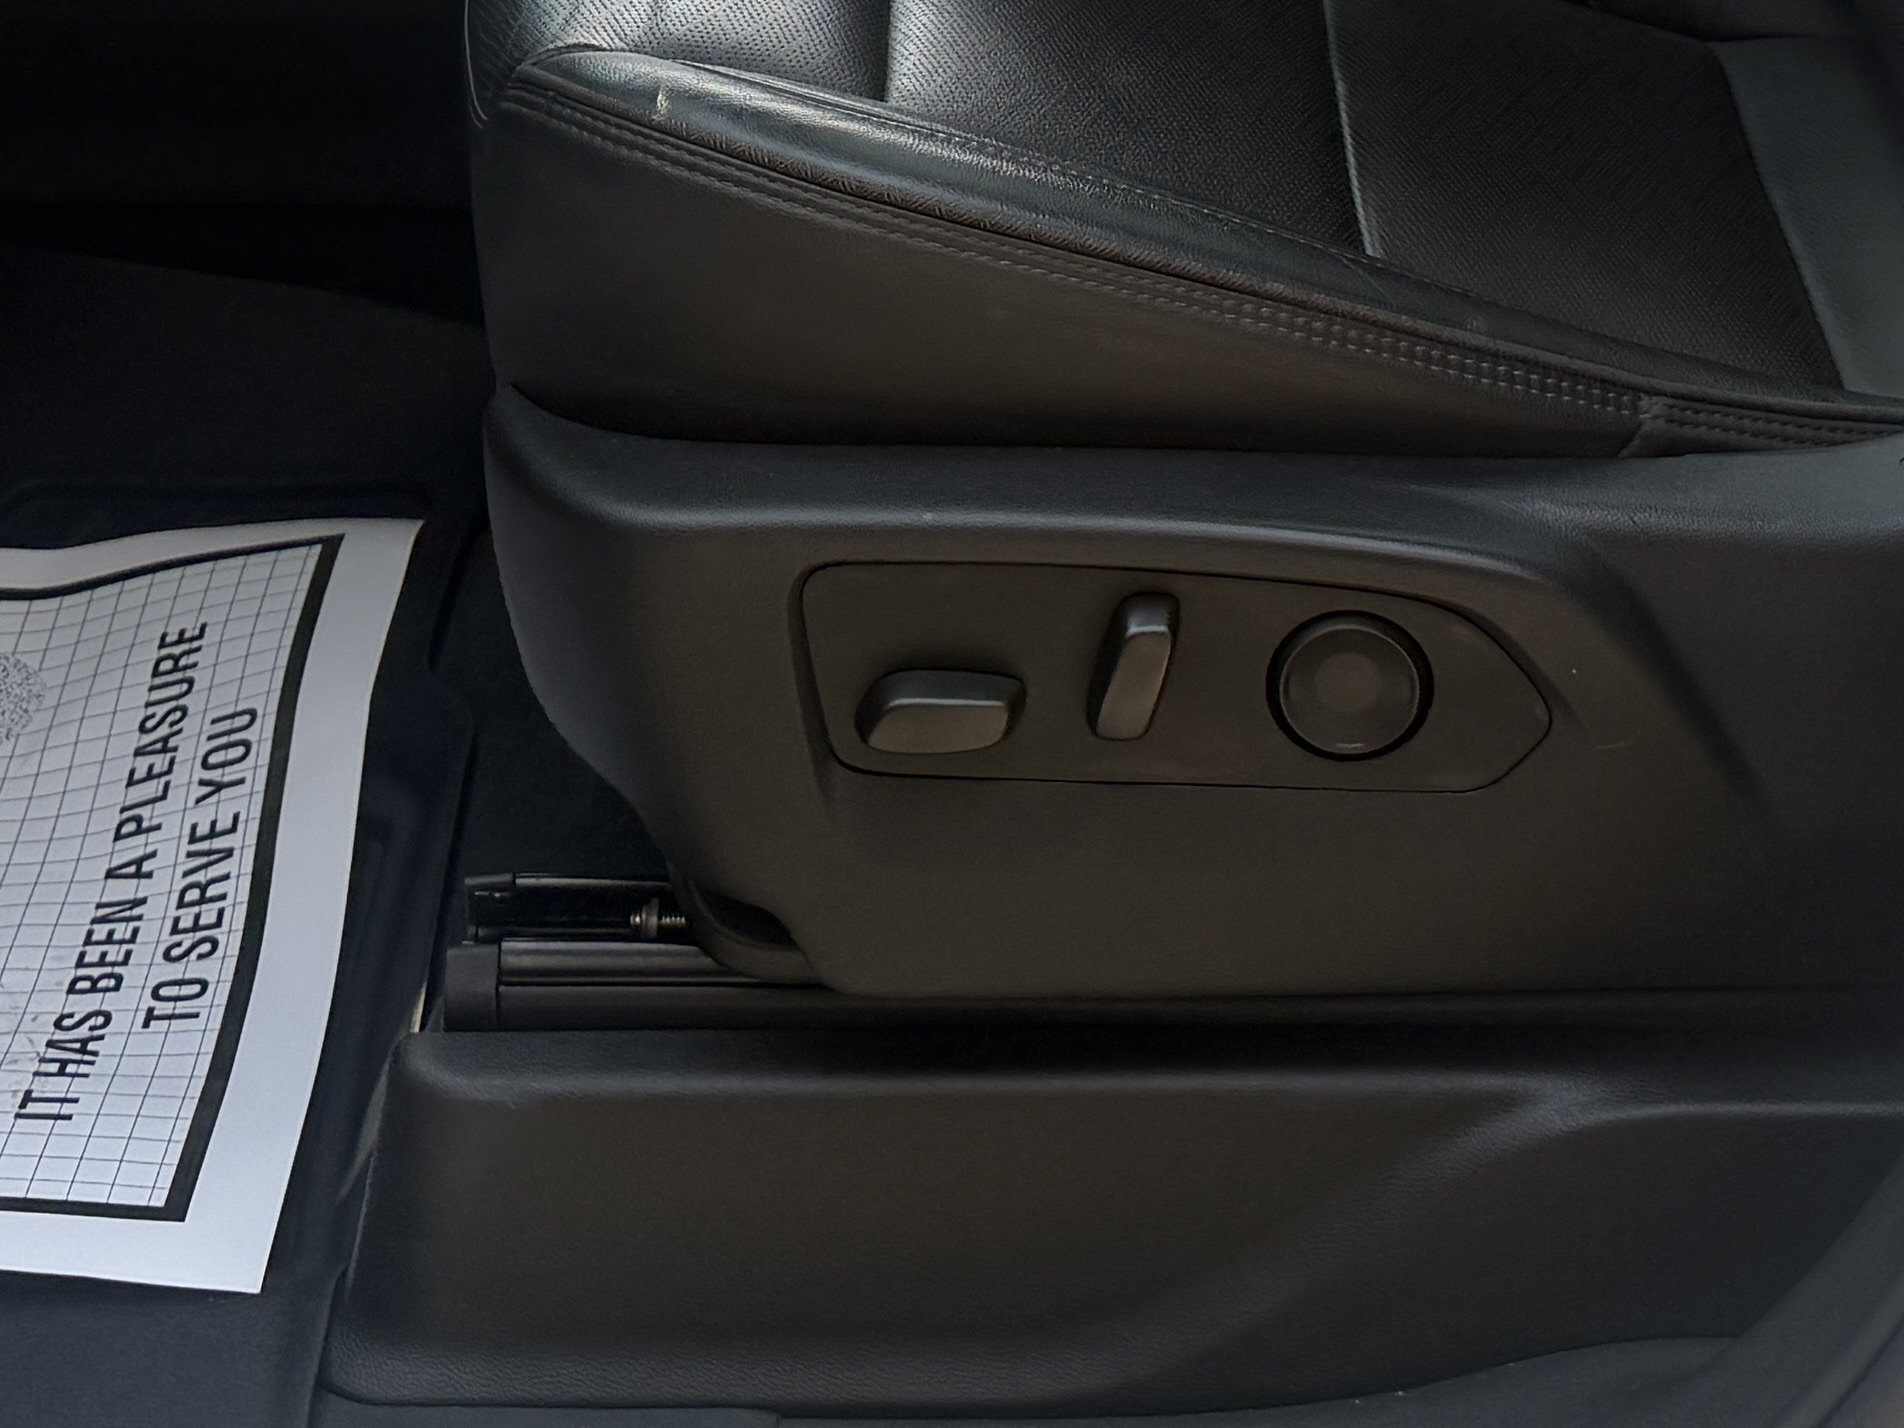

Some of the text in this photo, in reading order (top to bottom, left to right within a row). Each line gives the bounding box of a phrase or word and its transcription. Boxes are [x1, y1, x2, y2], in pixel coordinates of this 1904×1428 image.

[13, 621, 209, 1121] IT HAS BEEN A PLEASURE
[141, 706, 260, 1031] TO SERVE YOU
